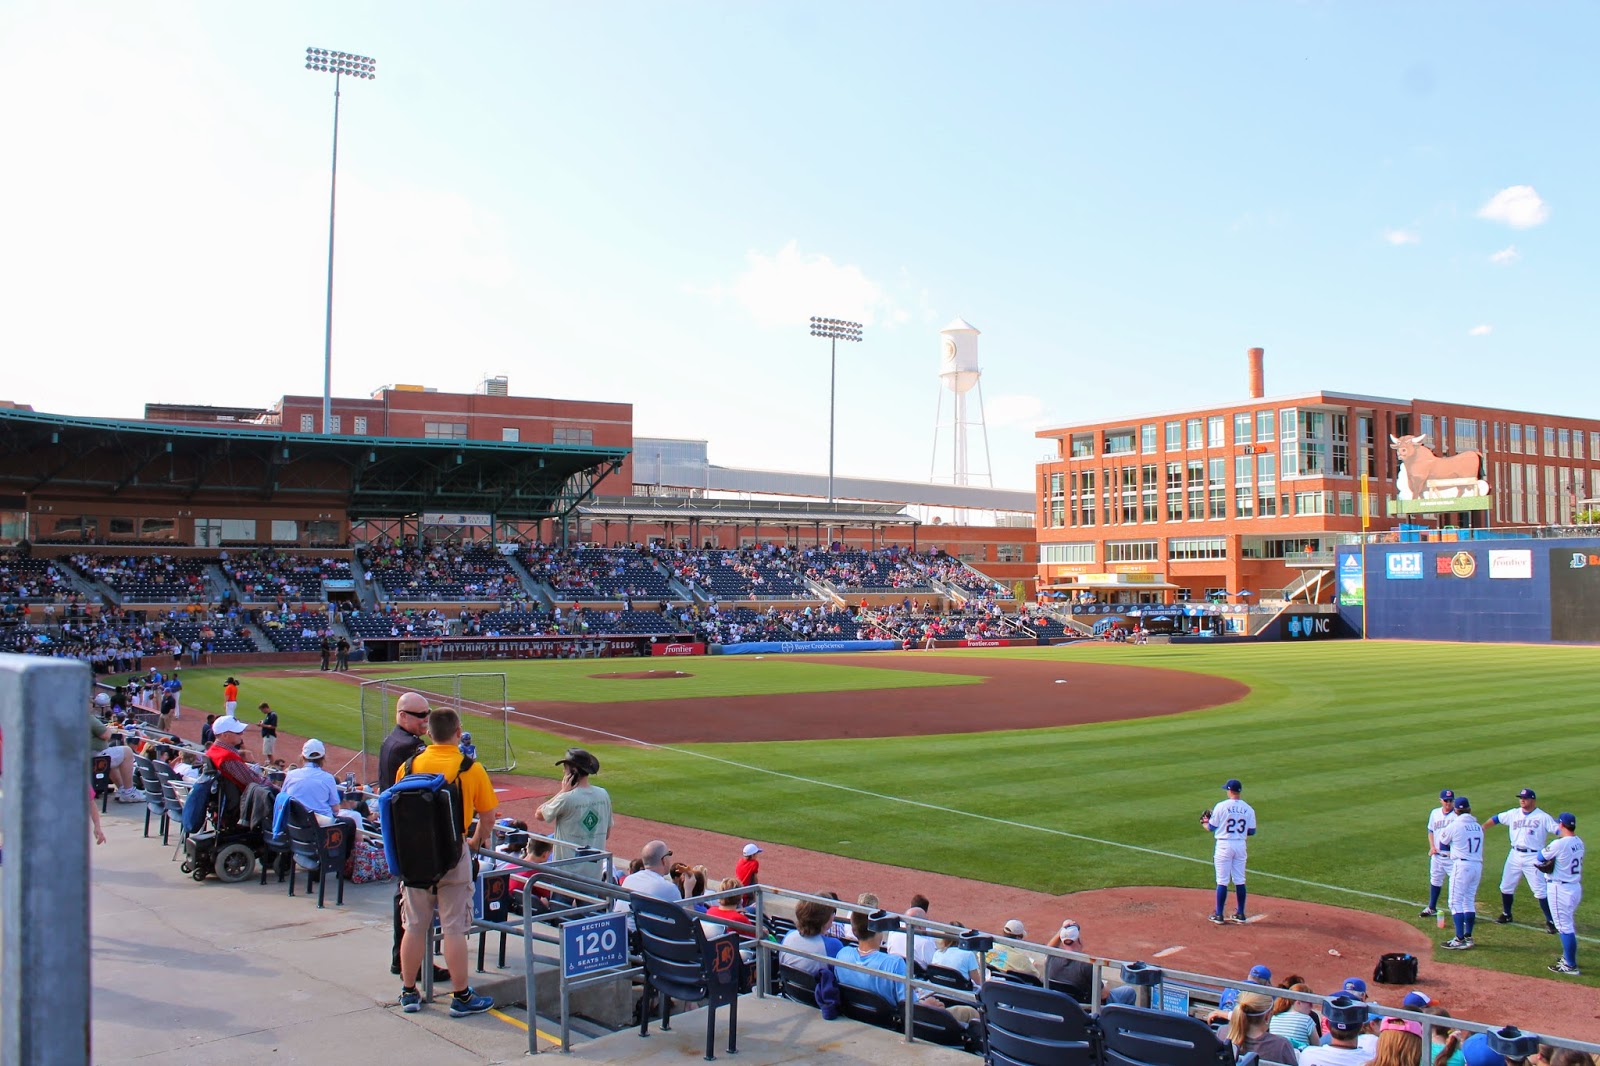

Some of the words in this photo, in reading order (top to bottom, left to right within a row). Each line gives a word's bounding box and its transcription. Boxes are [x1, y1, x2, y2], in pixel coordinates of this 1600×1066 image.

[1388, 554, 1421, 572] CEI
[1493, 556, 1527, 567] frontier
[1588, 554, 1600, 566] B
[1315, 618, 1330, 632] NC
[499, 642, 530, 651] BETTER
[532, 642, 554, 650] WITH
[663, 644, 693, 655] frontier
[794, 643, 810, 651] Bayer
[811, 642, 844, 650] CropScience
[1227, 806, 1248, 814] KELLY
[1226, 818, 1247, 834] 23
[1513, 819, 1540, 830] BULLS
[1467, 837, 1481, 853] 17
[581, 920, 611, 931] SECTION
[575, 929, 617, 956] 120
[577, 956, 599, 966] SEATS
[601, 953, 615, 961] 1-12
